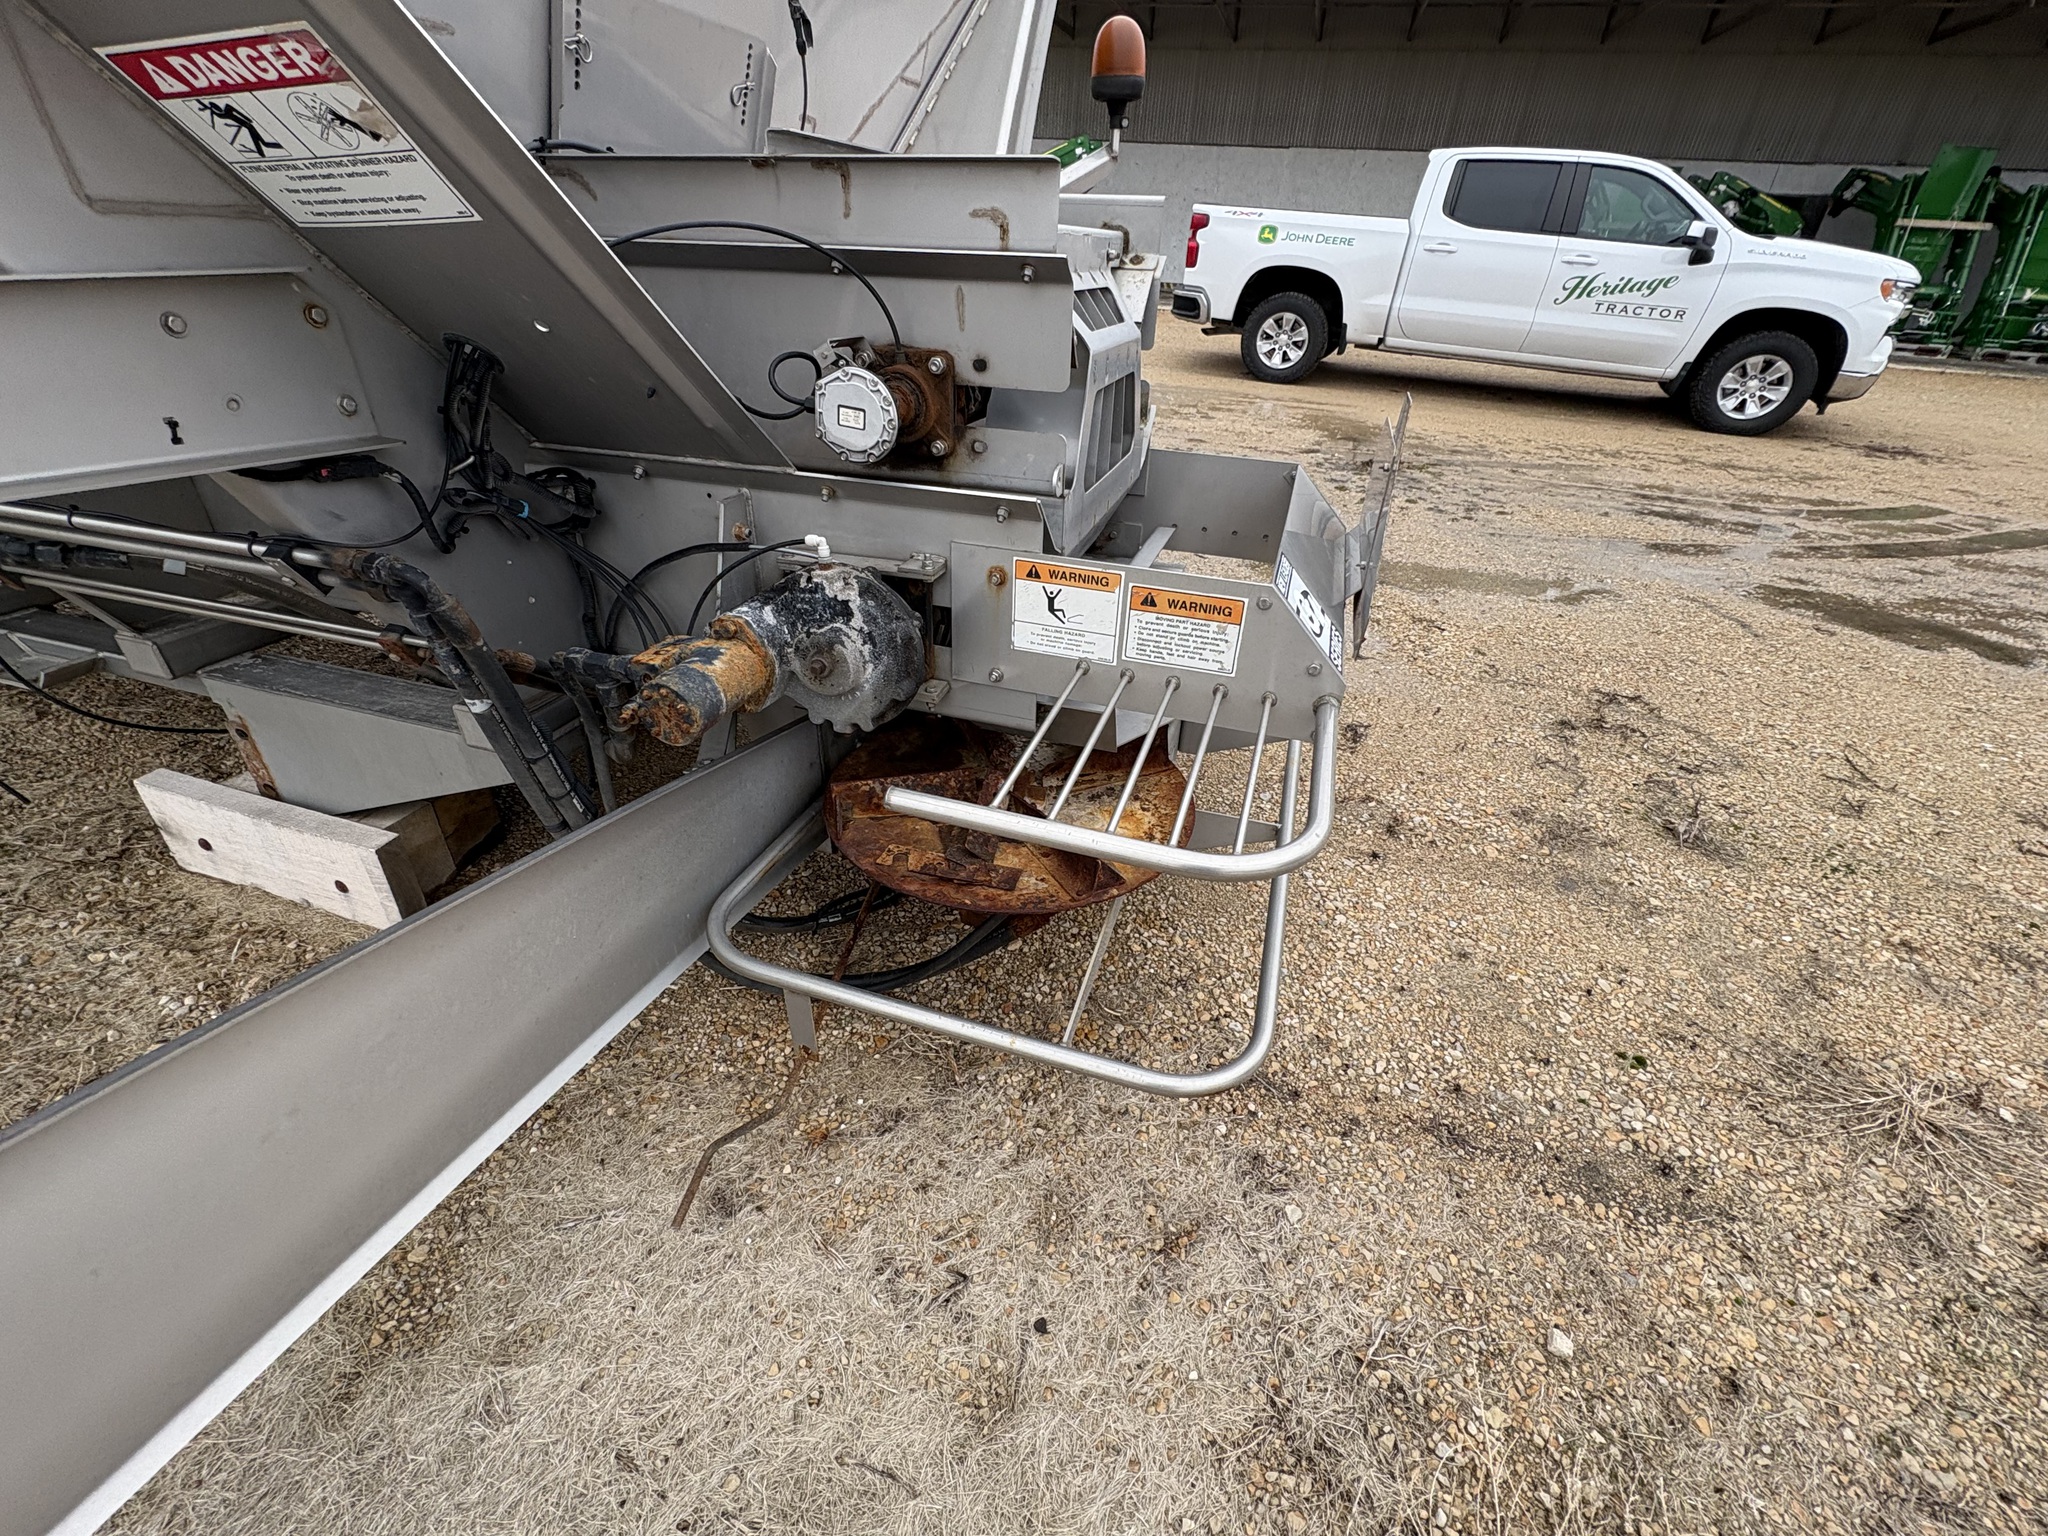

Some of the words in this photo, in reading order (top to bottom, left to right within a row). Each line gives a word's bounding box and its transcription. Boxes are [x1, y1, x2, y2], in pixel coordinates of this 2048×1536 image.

[164, 39, 321, 89] DANGER
[239, 165, 268, 173] FLYING
[264, 163, 304, 172] MATERIAL
[308, 159, 349, 169] ROTATING
[347, 157, 384, 167] SPINNER
[381, 154, 417, 164] HAZARD
[1281, 230, 1314, 243] JOHN
[1315, 233, 1356, 247] DEERE
[1553, 272, 1680, 305] Heritage
[1595, 302, 1686, 321] TRACTOR
[1048, 569, 1109, 587] WARNING
[1167, 598, 1232, 617] WARNING
[1155, 615, 1174, 623] MOVING
